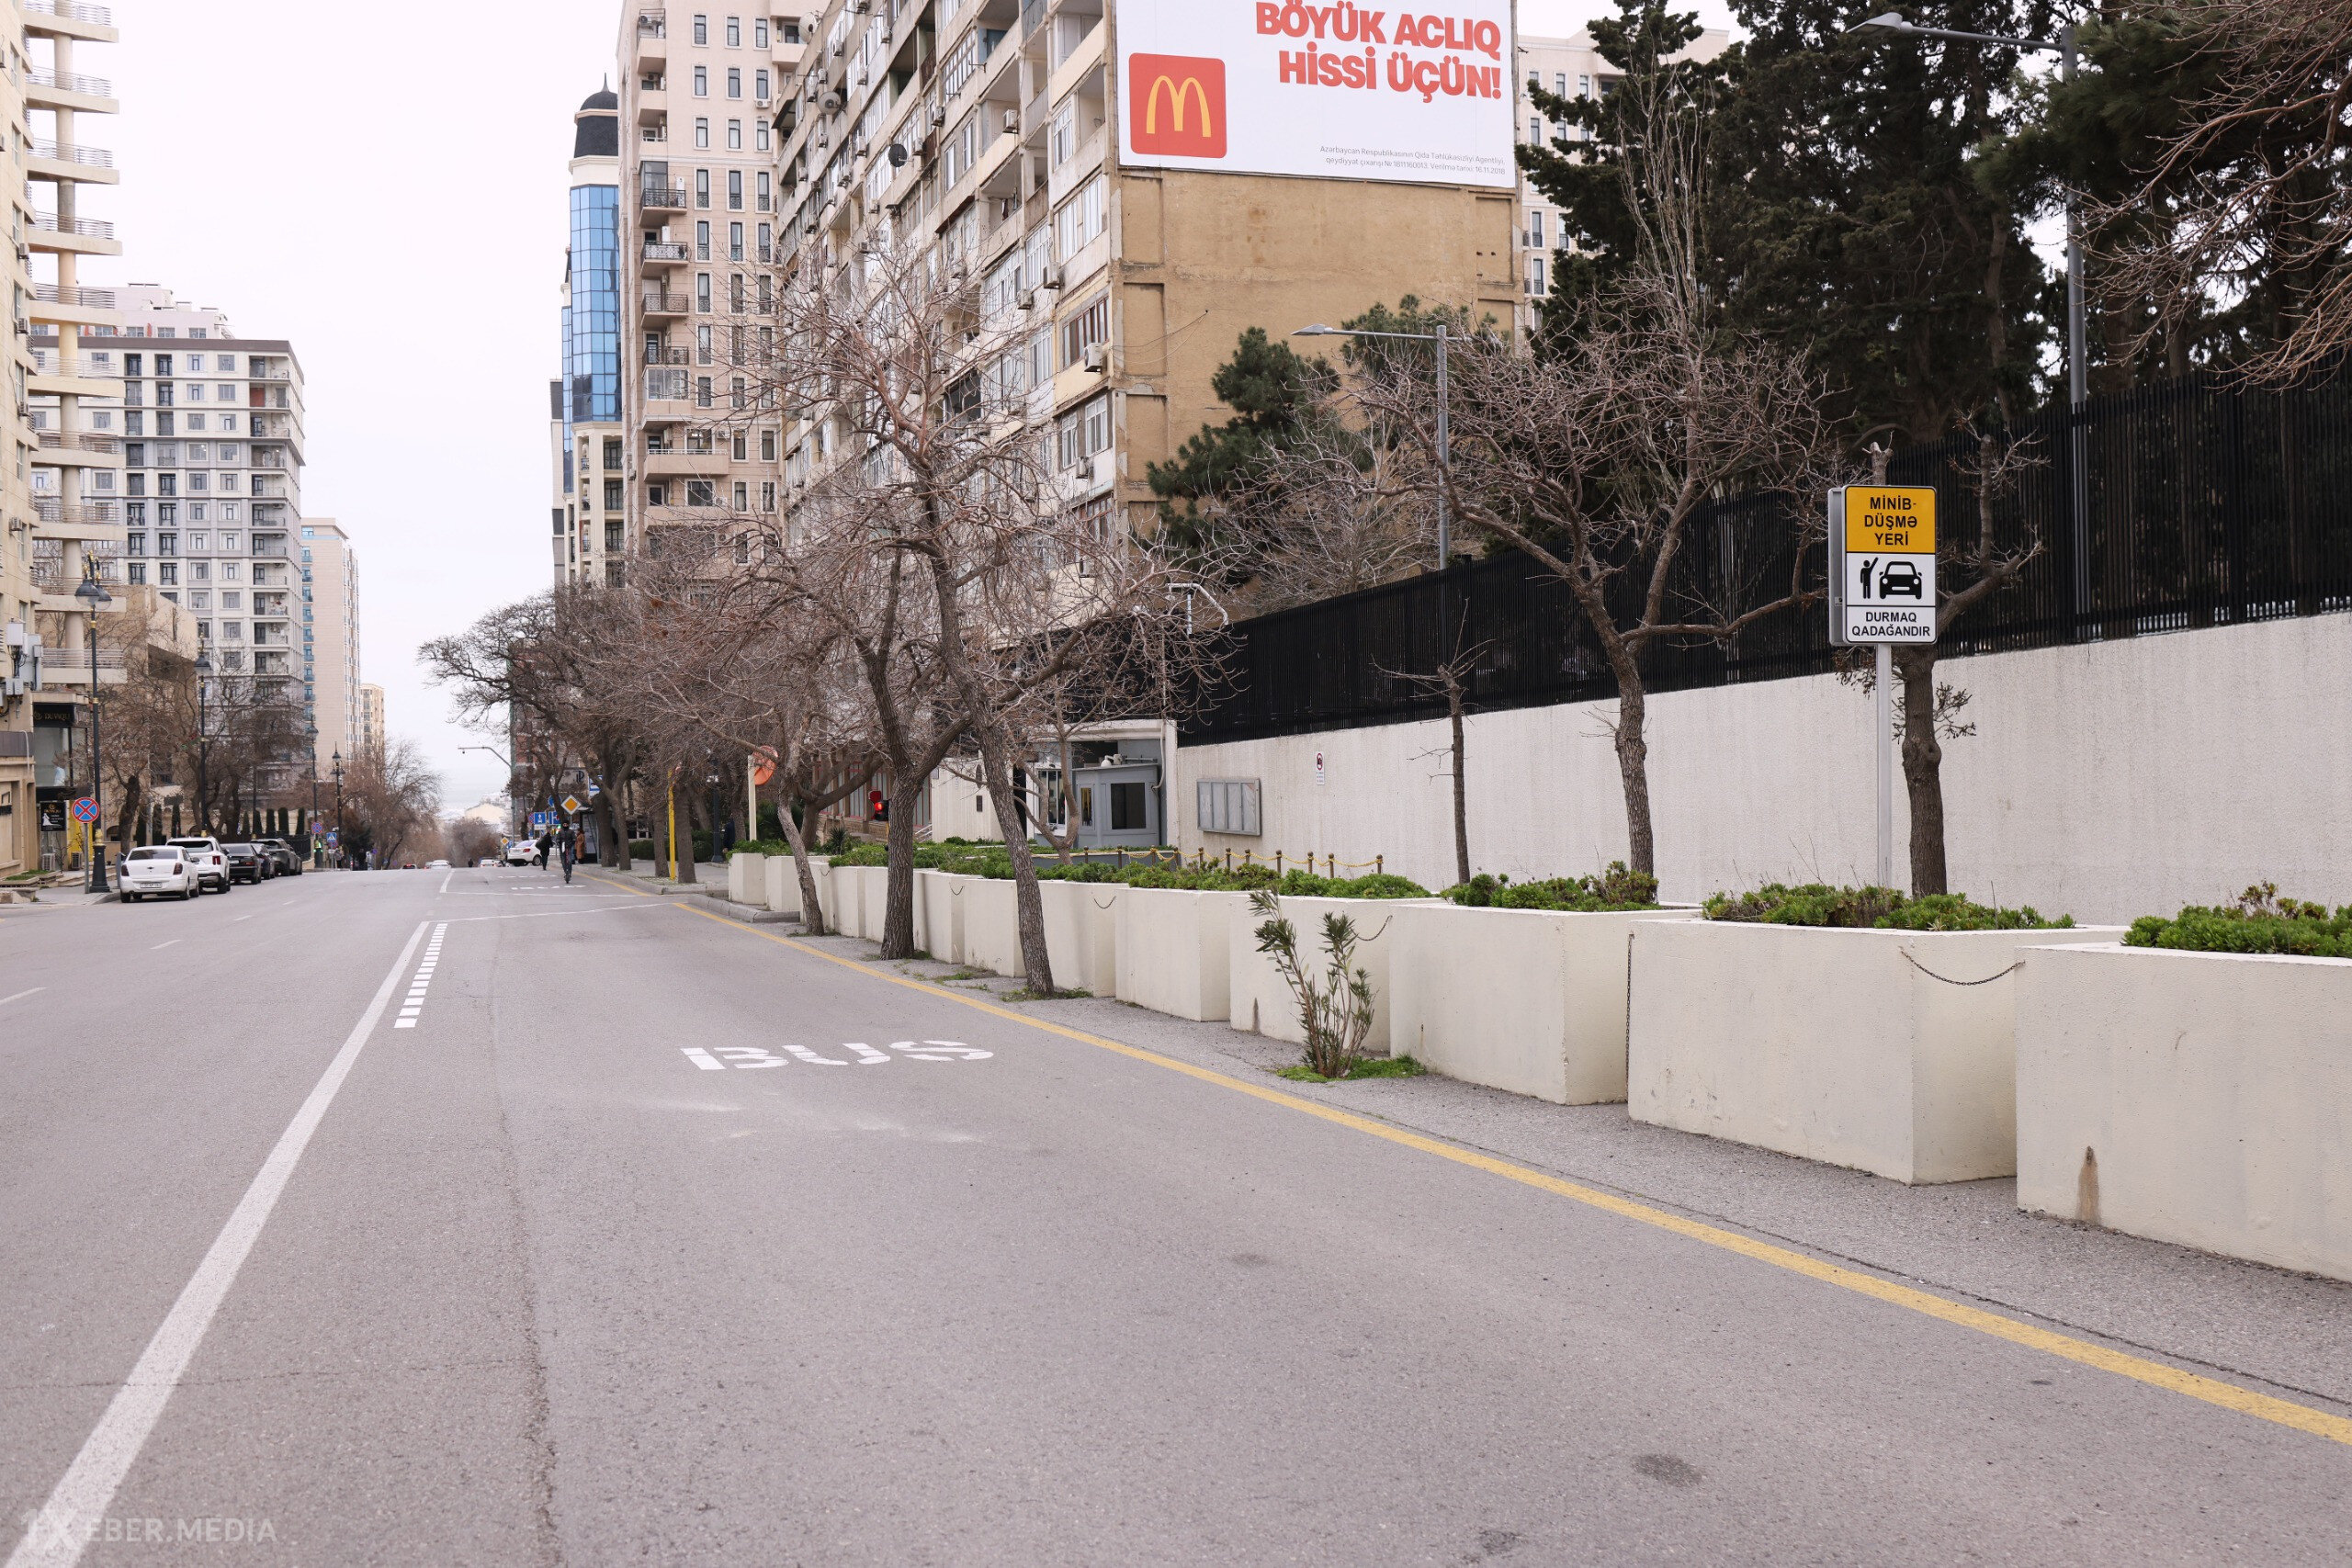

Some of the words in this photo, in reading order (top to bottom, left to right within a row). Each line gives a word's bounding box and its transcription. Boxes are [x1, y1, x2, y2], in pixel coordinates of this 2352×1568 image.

[1256, 0, 1387, 44] BÖYÜK
[1393, 13, 1501, 62] ACLIQ
[1279, 41, 1377, 90] HİSSİ
[1386, 51, 1502, 103] ÜÇÜN!
[1476, 166, 1506, 175] 16.11.2018
[1870, 494, 1917, 511] MİNİB-
[1864, 513, 1917, 530] DÜŞMƏ
[1874, 531, 1909, 546] YERİ
[1865, 612, 1917, 623] DURMAQ
[1852, 624, 1930, 637] QADAĞANDIR
[679, 1040, 994, 1070] BUS
